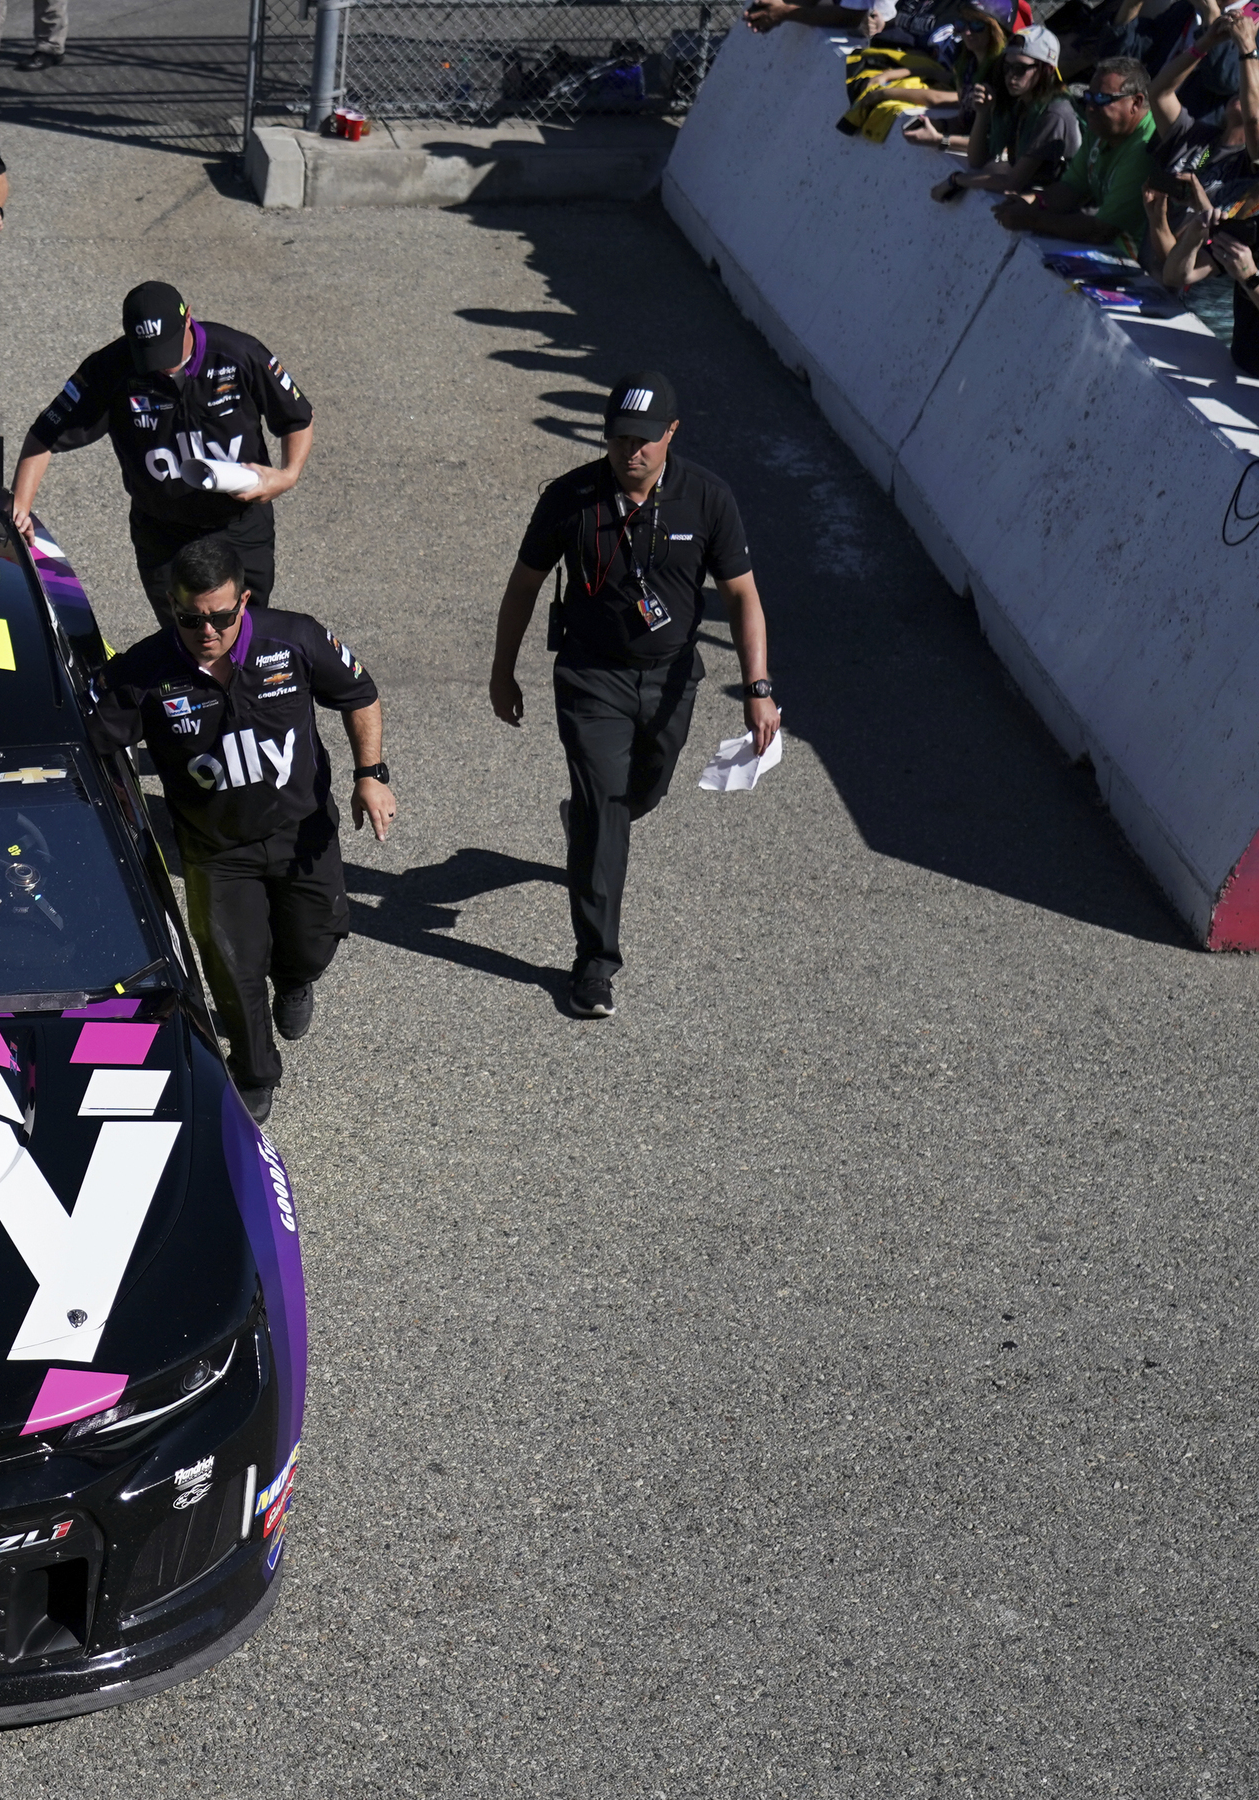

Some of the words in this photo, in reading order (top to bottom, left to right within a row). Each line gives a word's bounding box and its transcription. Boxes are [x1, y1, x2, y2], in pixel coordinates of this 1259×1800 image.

[135, 318, 162, 336] ally
[133, 414, 159, 431] ally
[255, 650, 291, 668] Hendrick
[257, 686, 297, 699] GOODYEAR
[171, 717, 202, 736] ally
[187, 727, 296, 792] ally
